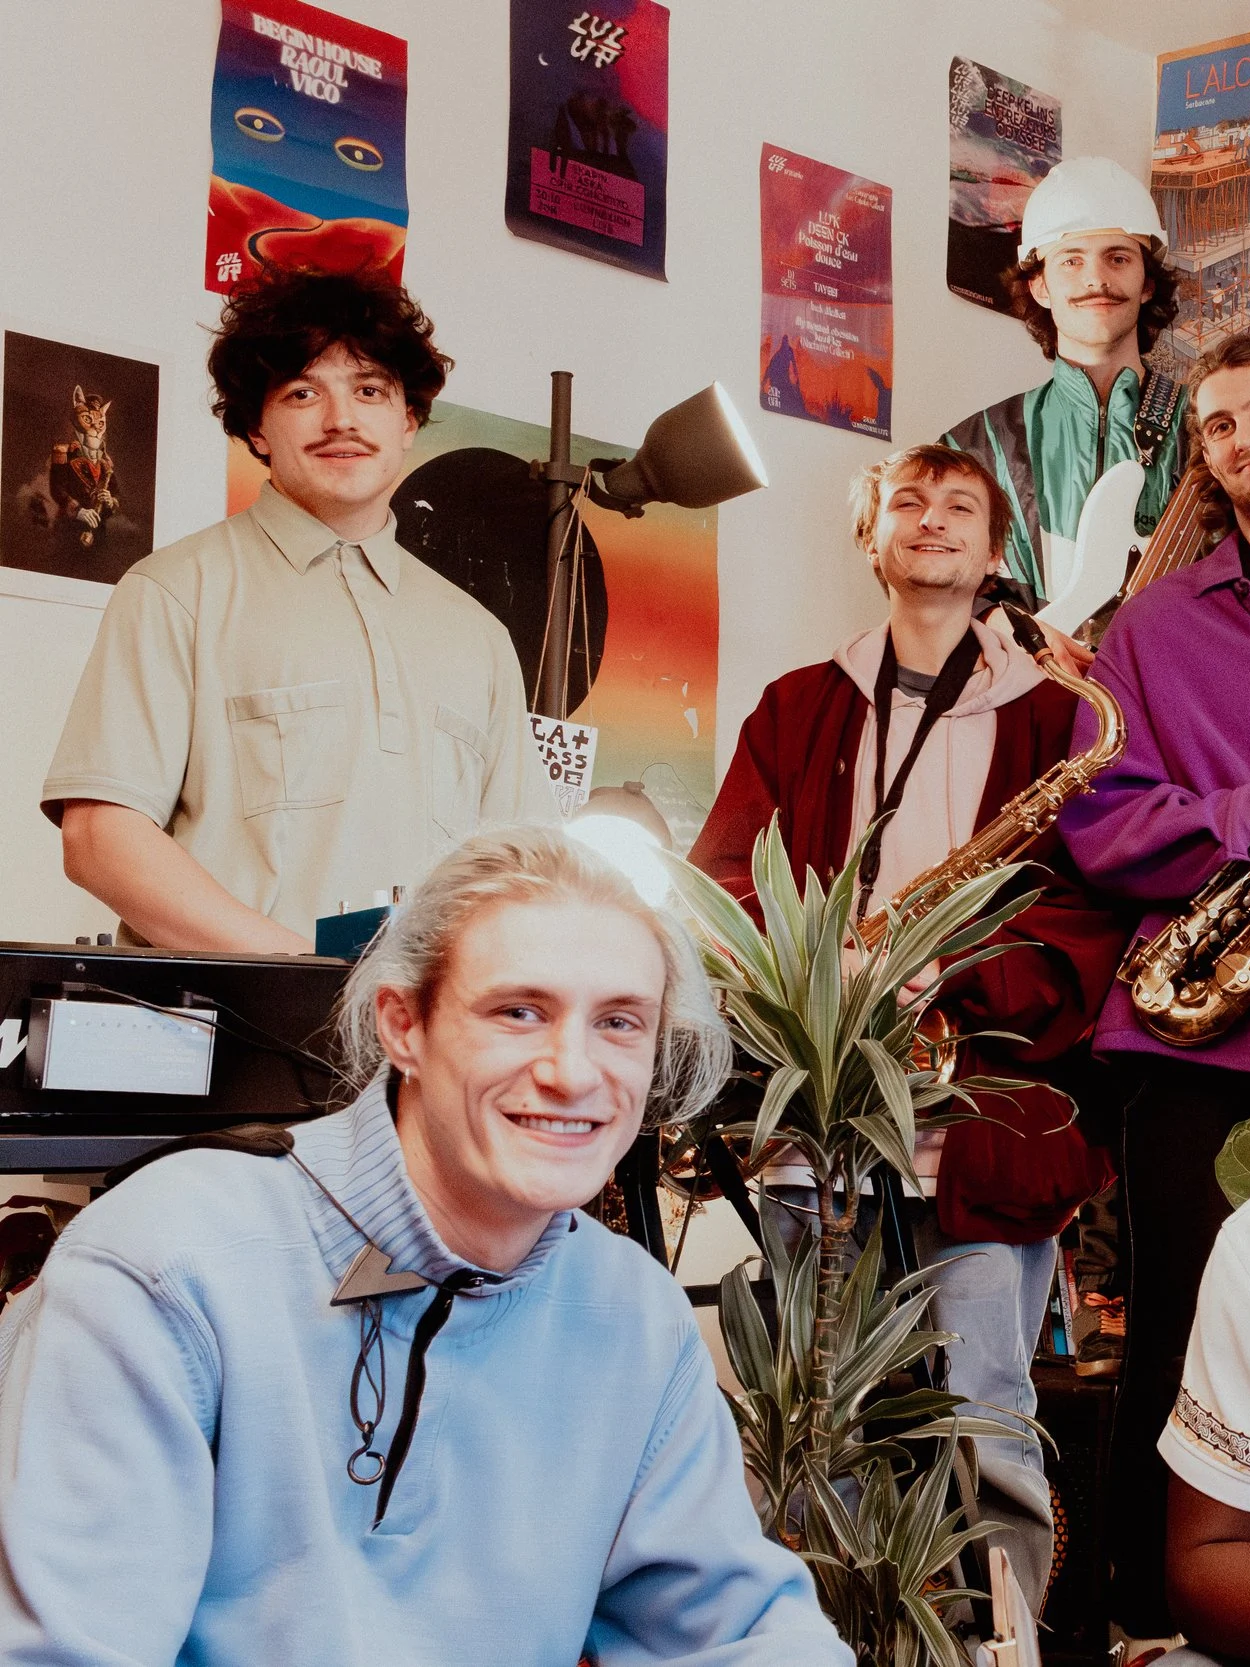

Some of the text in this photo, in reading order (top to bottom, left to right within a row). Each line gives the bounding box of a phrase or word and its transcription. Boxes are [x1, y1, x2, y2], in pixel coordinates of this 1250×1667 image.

[252, 12, 382, 80] BEGIN HOUSE
[280, 44, 348, 88] RAOUL
[290, 69, 340, 104] VICO
[798, 230, 833, 254] Poisson
[815, 251, 842, 269] douce
